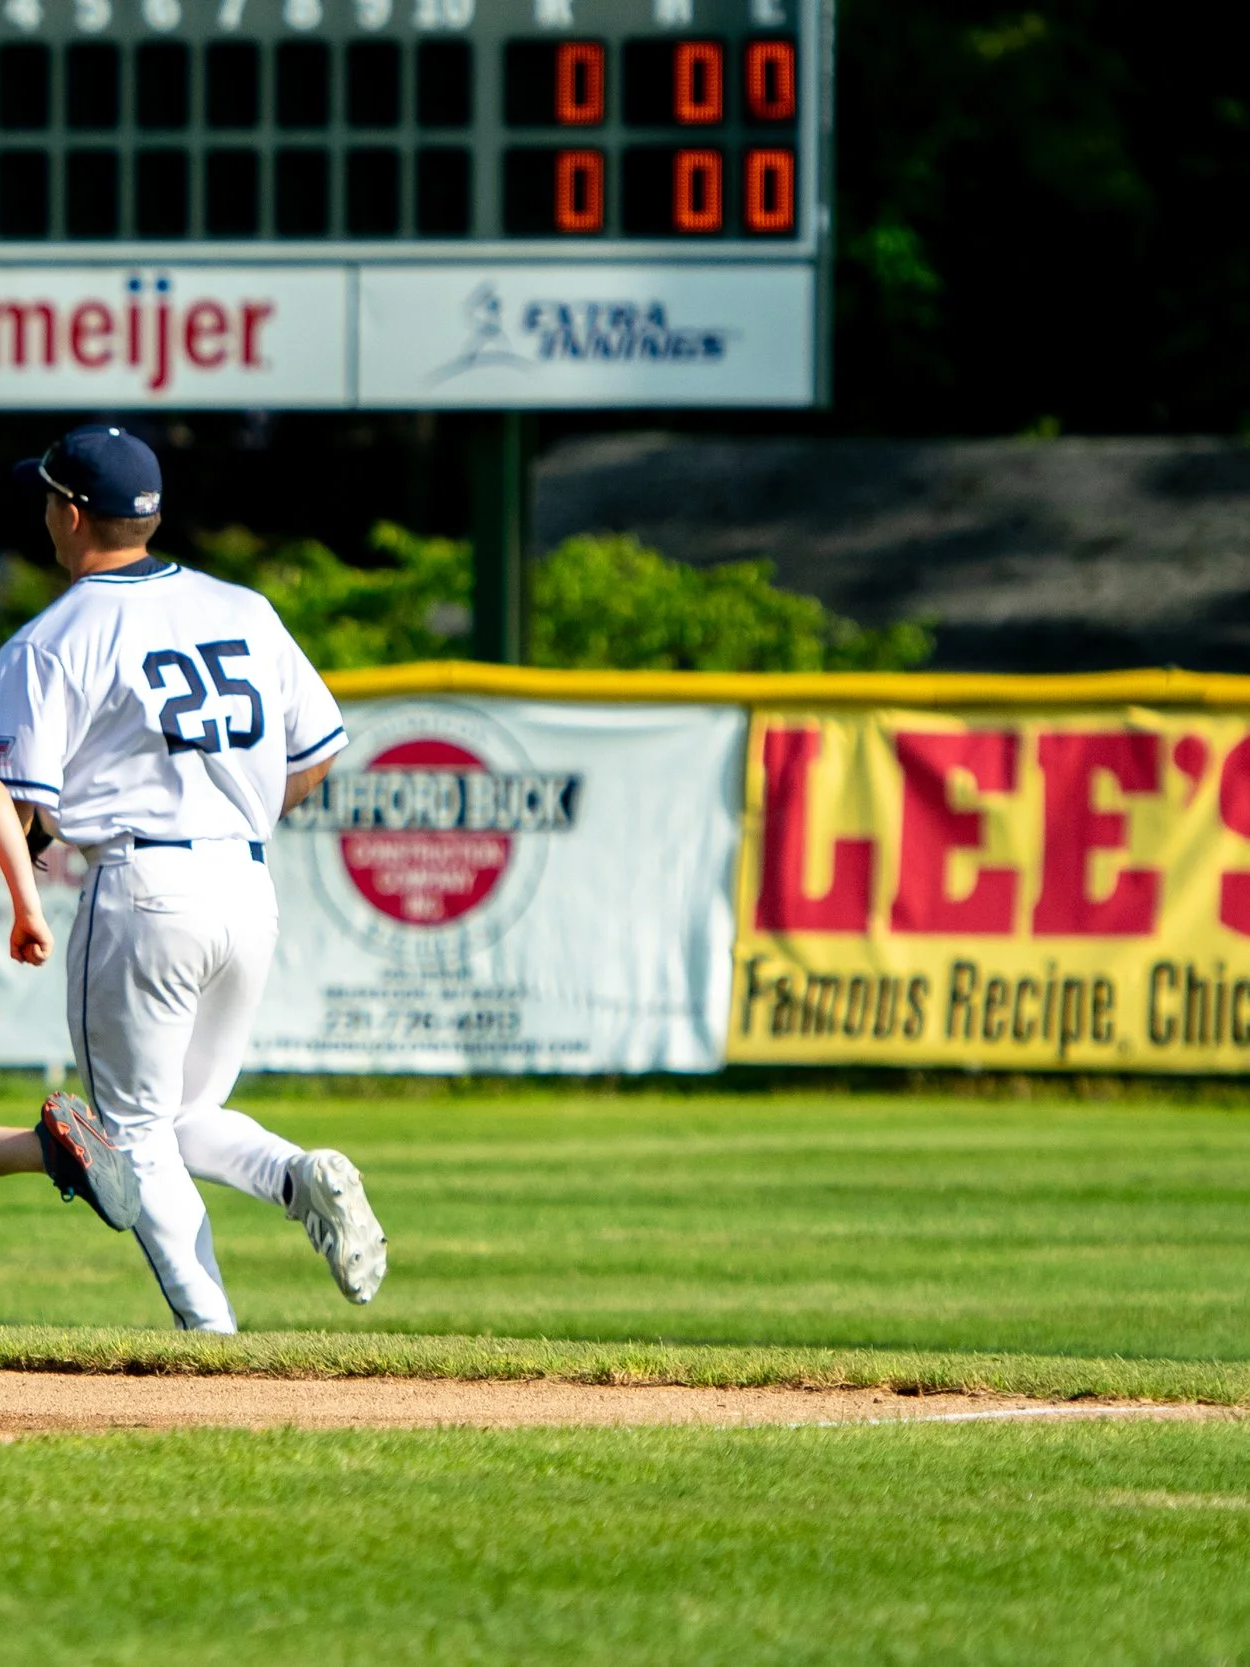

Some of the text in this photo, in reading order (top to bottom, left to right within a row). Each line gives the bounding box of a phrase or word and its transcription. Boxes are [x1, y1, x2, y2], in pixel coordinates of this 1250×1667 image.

[556, 41, 795, 124] 0 0 0
[556, 149, 794, 232] 0 0 0
[142, 639, 265, 755] 25
[470, 772, 576, 829] BUCK
[754, 728, 1250, 937] LEE'
[740, 956, 931, 1039] Famous
[945, 960, 1118, 1058] Recipe
